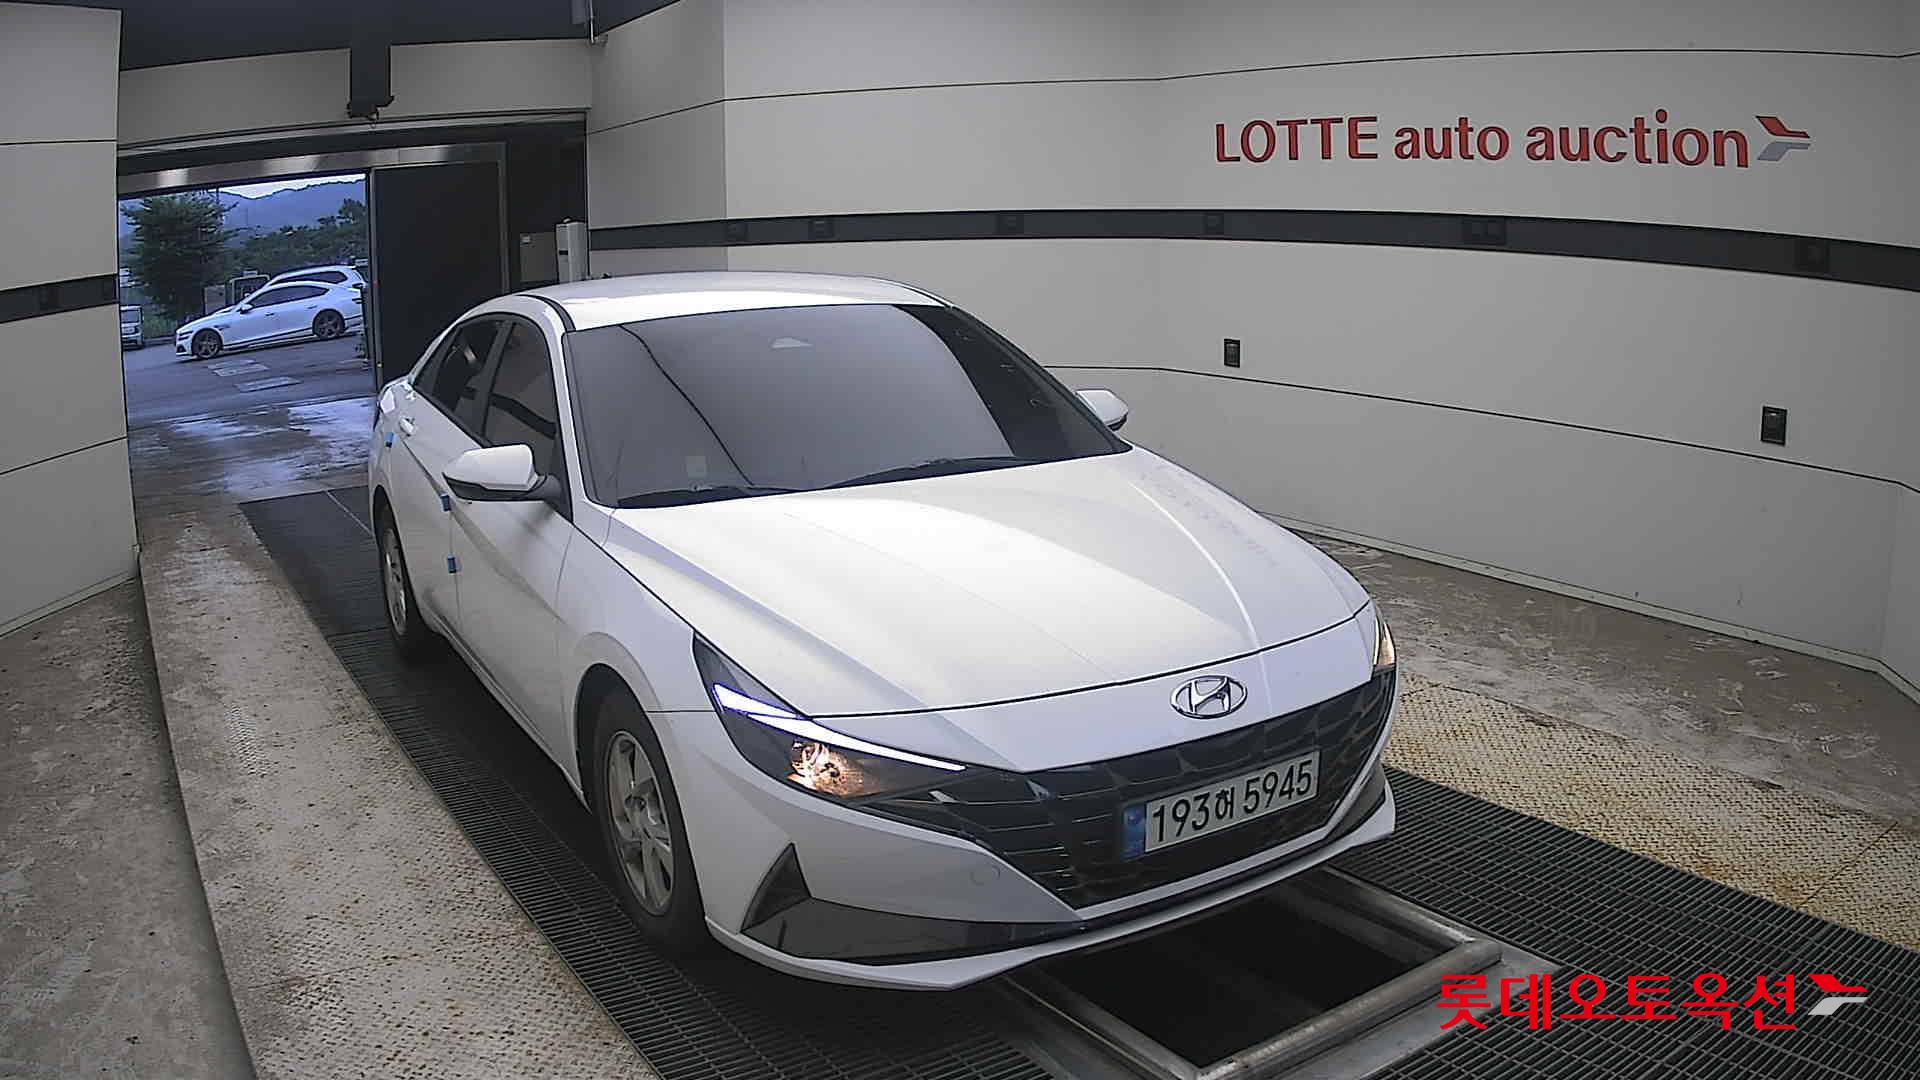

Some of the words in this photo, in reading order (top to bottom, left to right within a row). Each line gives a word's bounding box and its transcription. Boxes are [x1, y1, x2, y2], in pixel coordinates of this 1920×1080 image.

[1215, 116, 1378, 163] LOTTE
[1393, 117, 1510, 161] auto
[1526, 109, 1750, 168] auction
[1151, 786, 1236, 842] 193허
[1243, 759, 1313, 815] 5945
